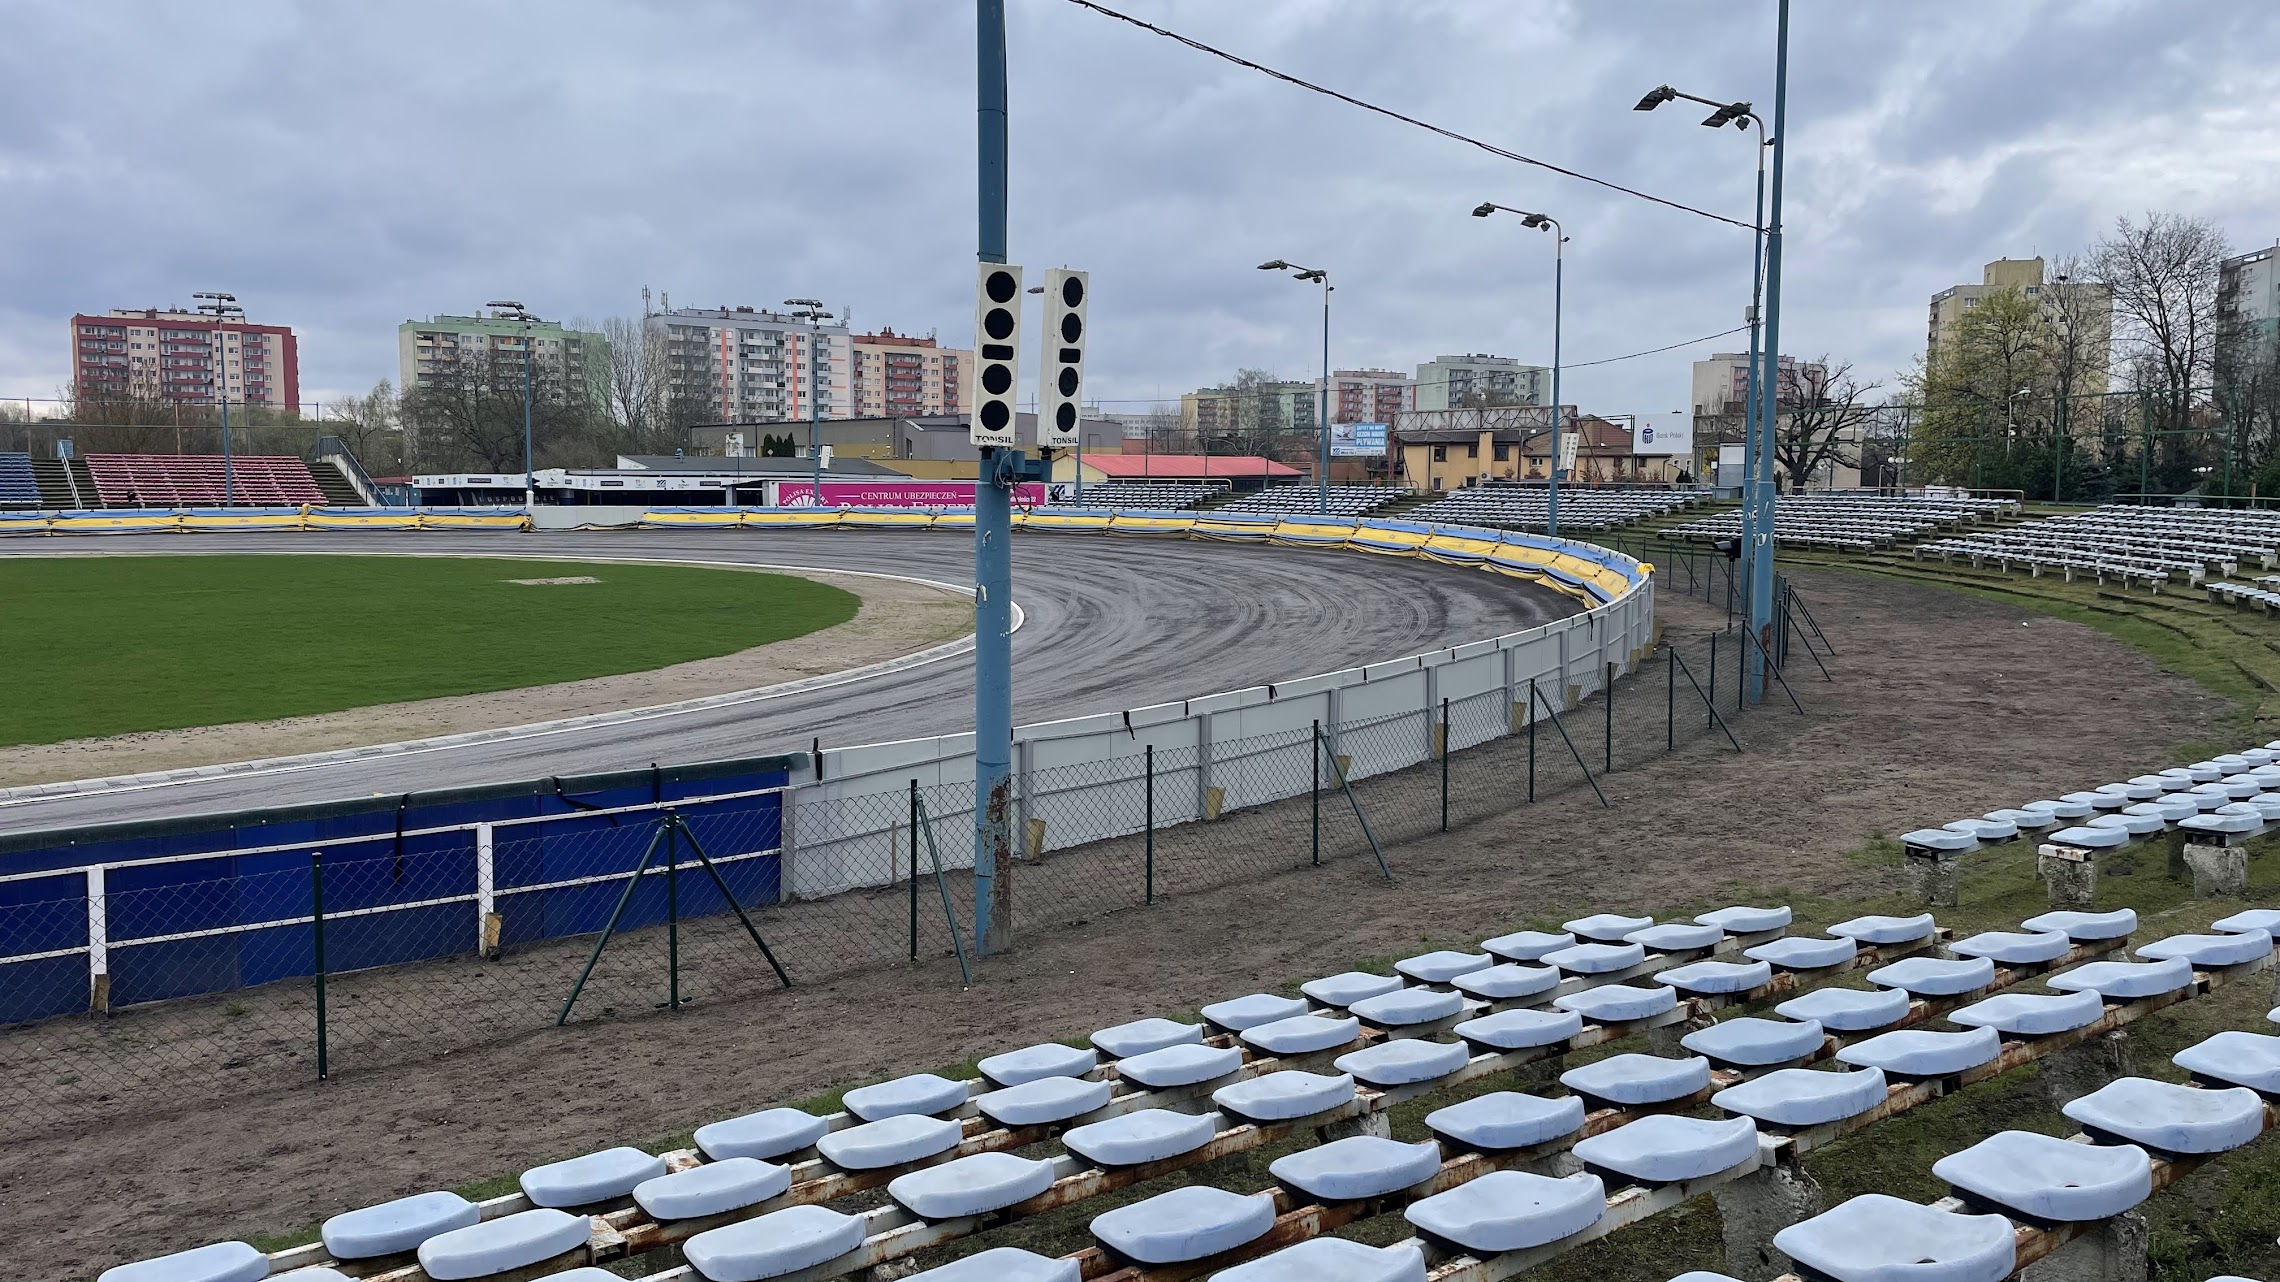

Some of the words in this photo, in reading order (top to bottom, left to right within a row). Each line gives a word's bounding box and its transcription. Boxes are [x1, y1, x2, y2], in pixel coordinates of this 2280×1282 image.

[975, 436, 1014, 444] TONSIL
[782, 489, 804, 505] POLISA
[860, 492, 902, 500] CENTRUM
[904, 490, 957, 500] UBEZPIECZEŃ
